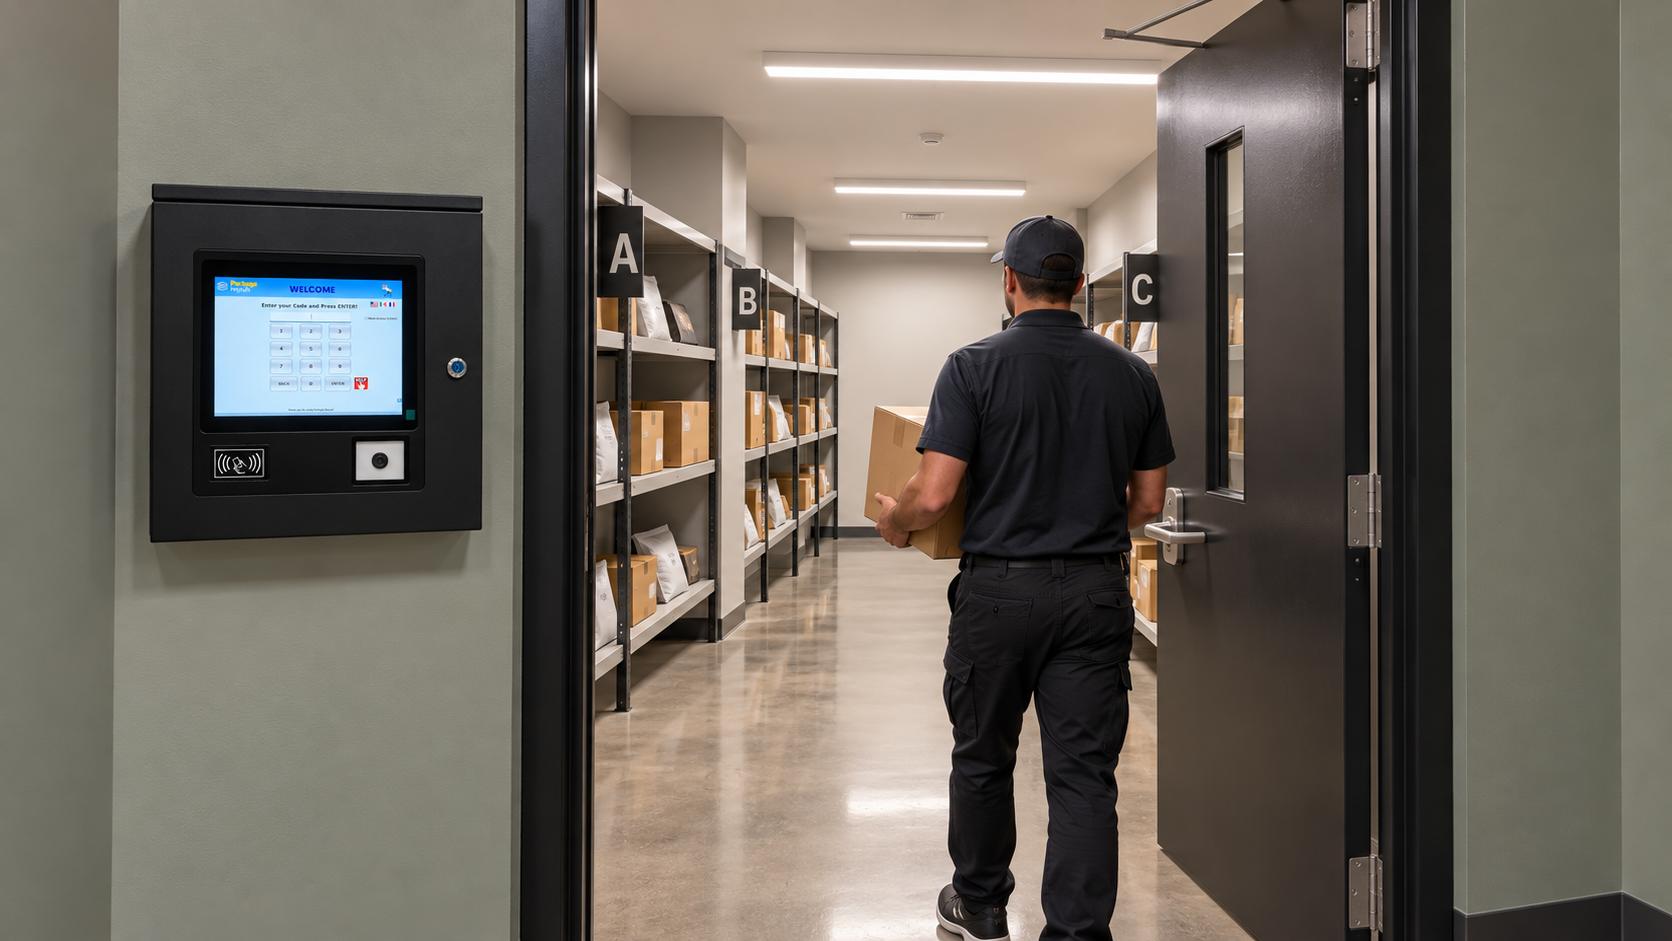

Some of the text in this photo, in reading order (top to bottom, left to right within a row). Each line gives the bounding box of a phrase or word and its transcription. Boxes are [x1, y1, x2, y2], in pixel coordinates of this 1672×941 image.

[609, 232, 639, 274] A
[289, 285, 336, 294] WELCOME
[738, 286, 758, 316] B
[1132, 273, 1153, 306] C
